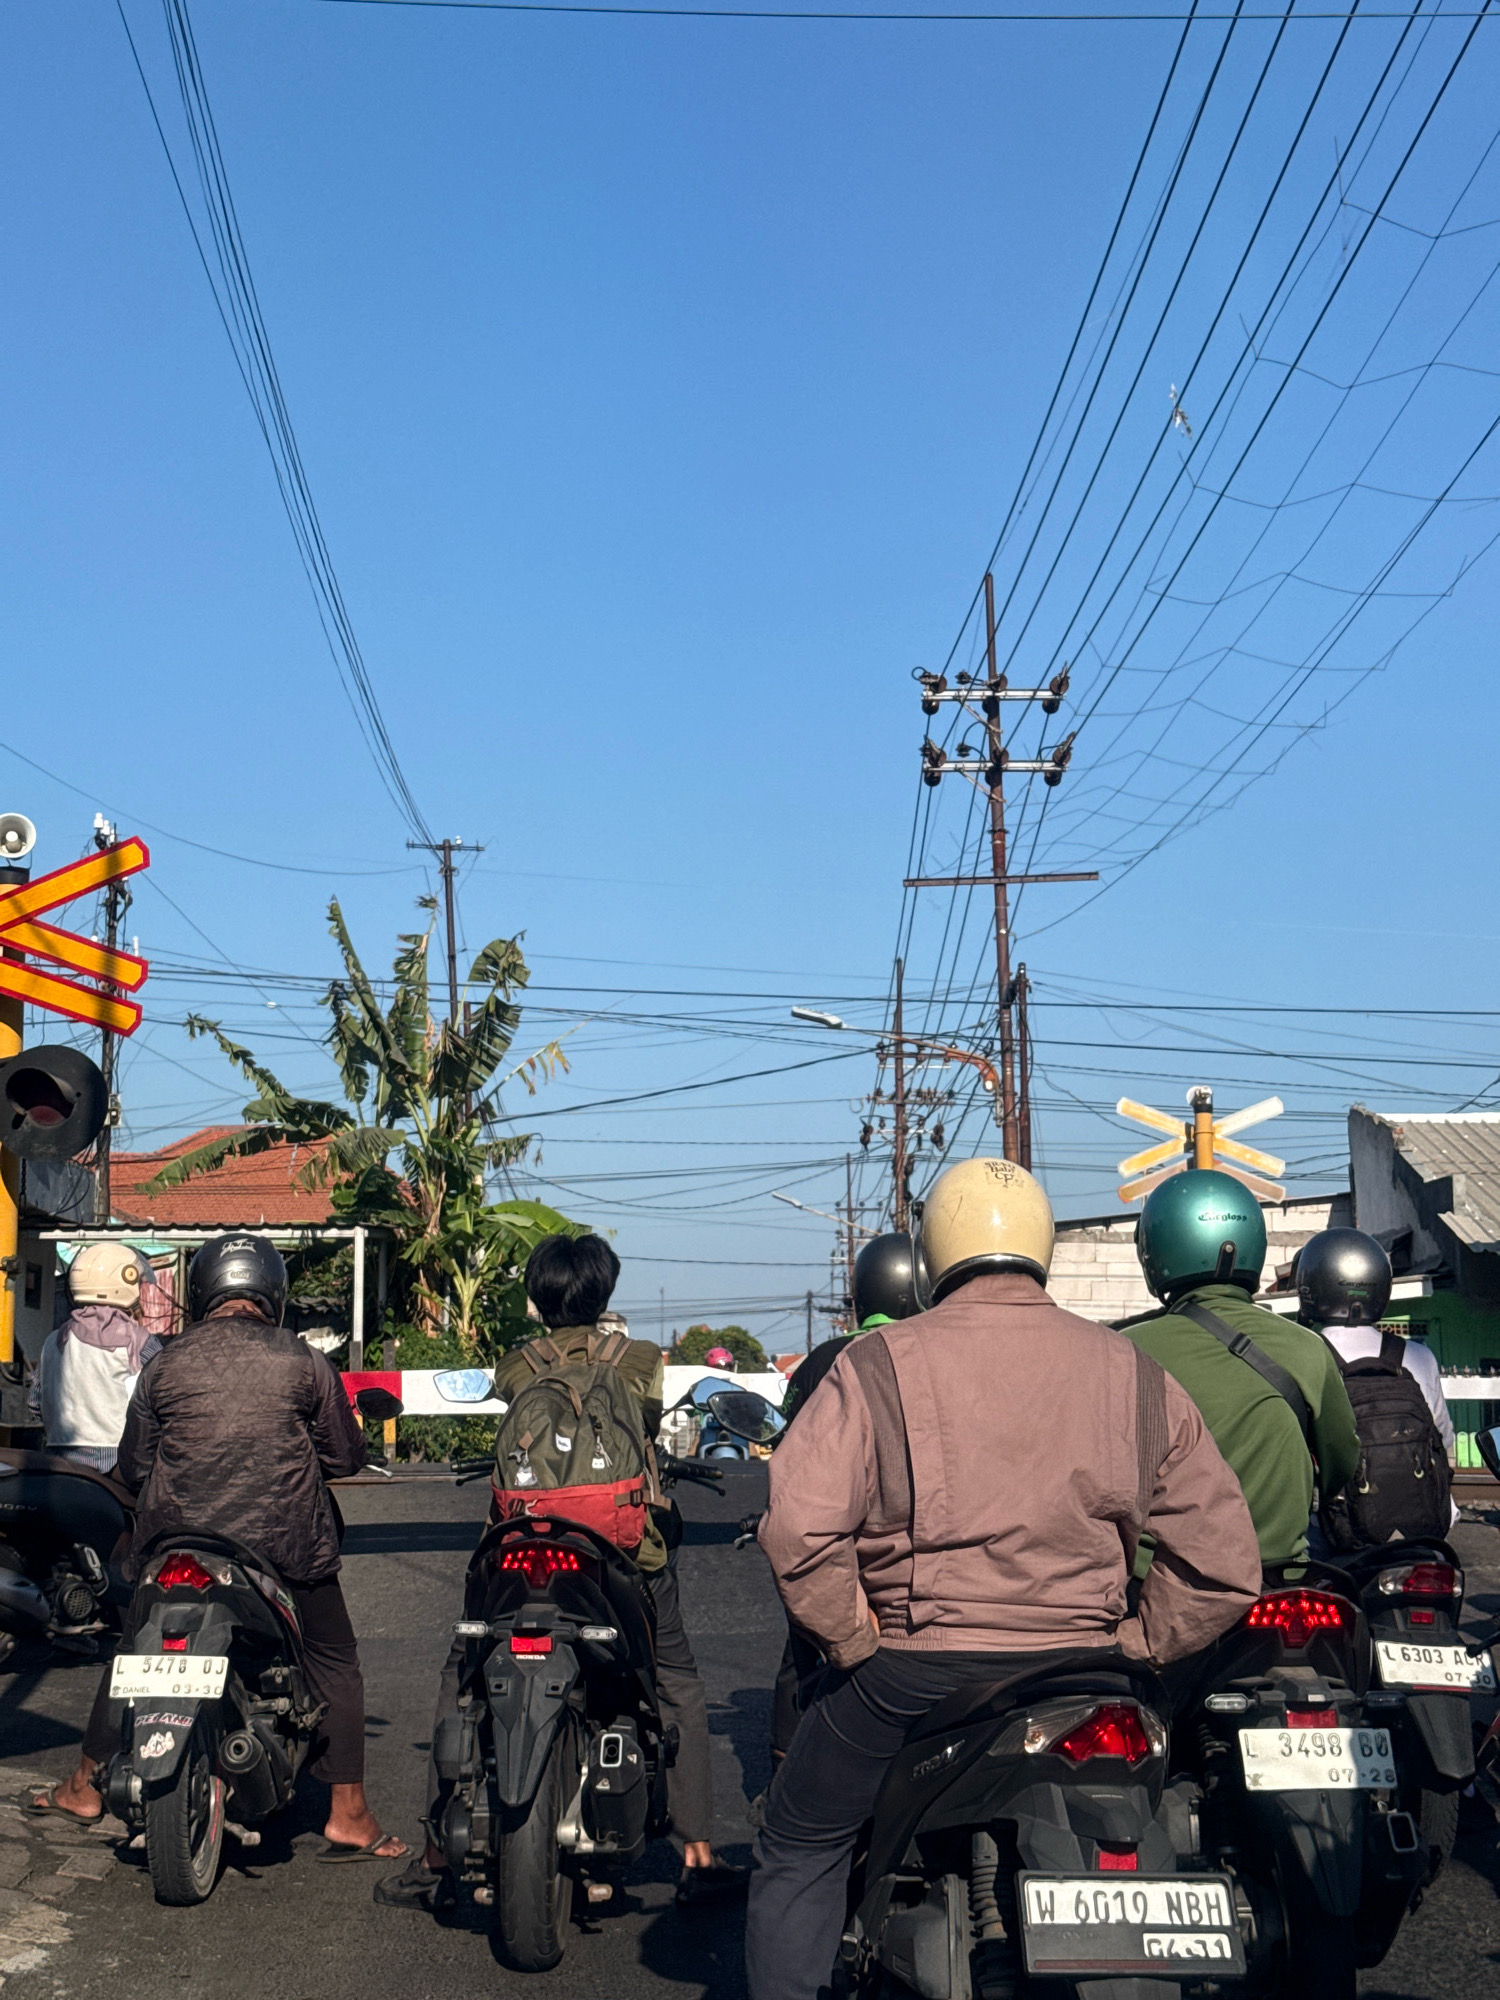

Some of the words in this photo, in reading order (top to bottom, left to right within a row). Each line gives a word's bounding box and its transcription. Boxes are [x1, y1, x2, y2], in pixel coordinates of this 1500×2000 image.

[116, 1657, 124, 1675] L
[142, 1656, 188, 1675] 5478
[1383, 1644, 1396, 1661] L
[1400, 1646, 1444, 1664] 6303
[1244, 1733, 1259, 1758] L
[1278, 1732, 1343, 1758] 3498
[1035, 1890, 1054, 1922] W
[1074, 1889, 1148, 1924] 6019
[1165, 1891, 1222, 1925] NBH
